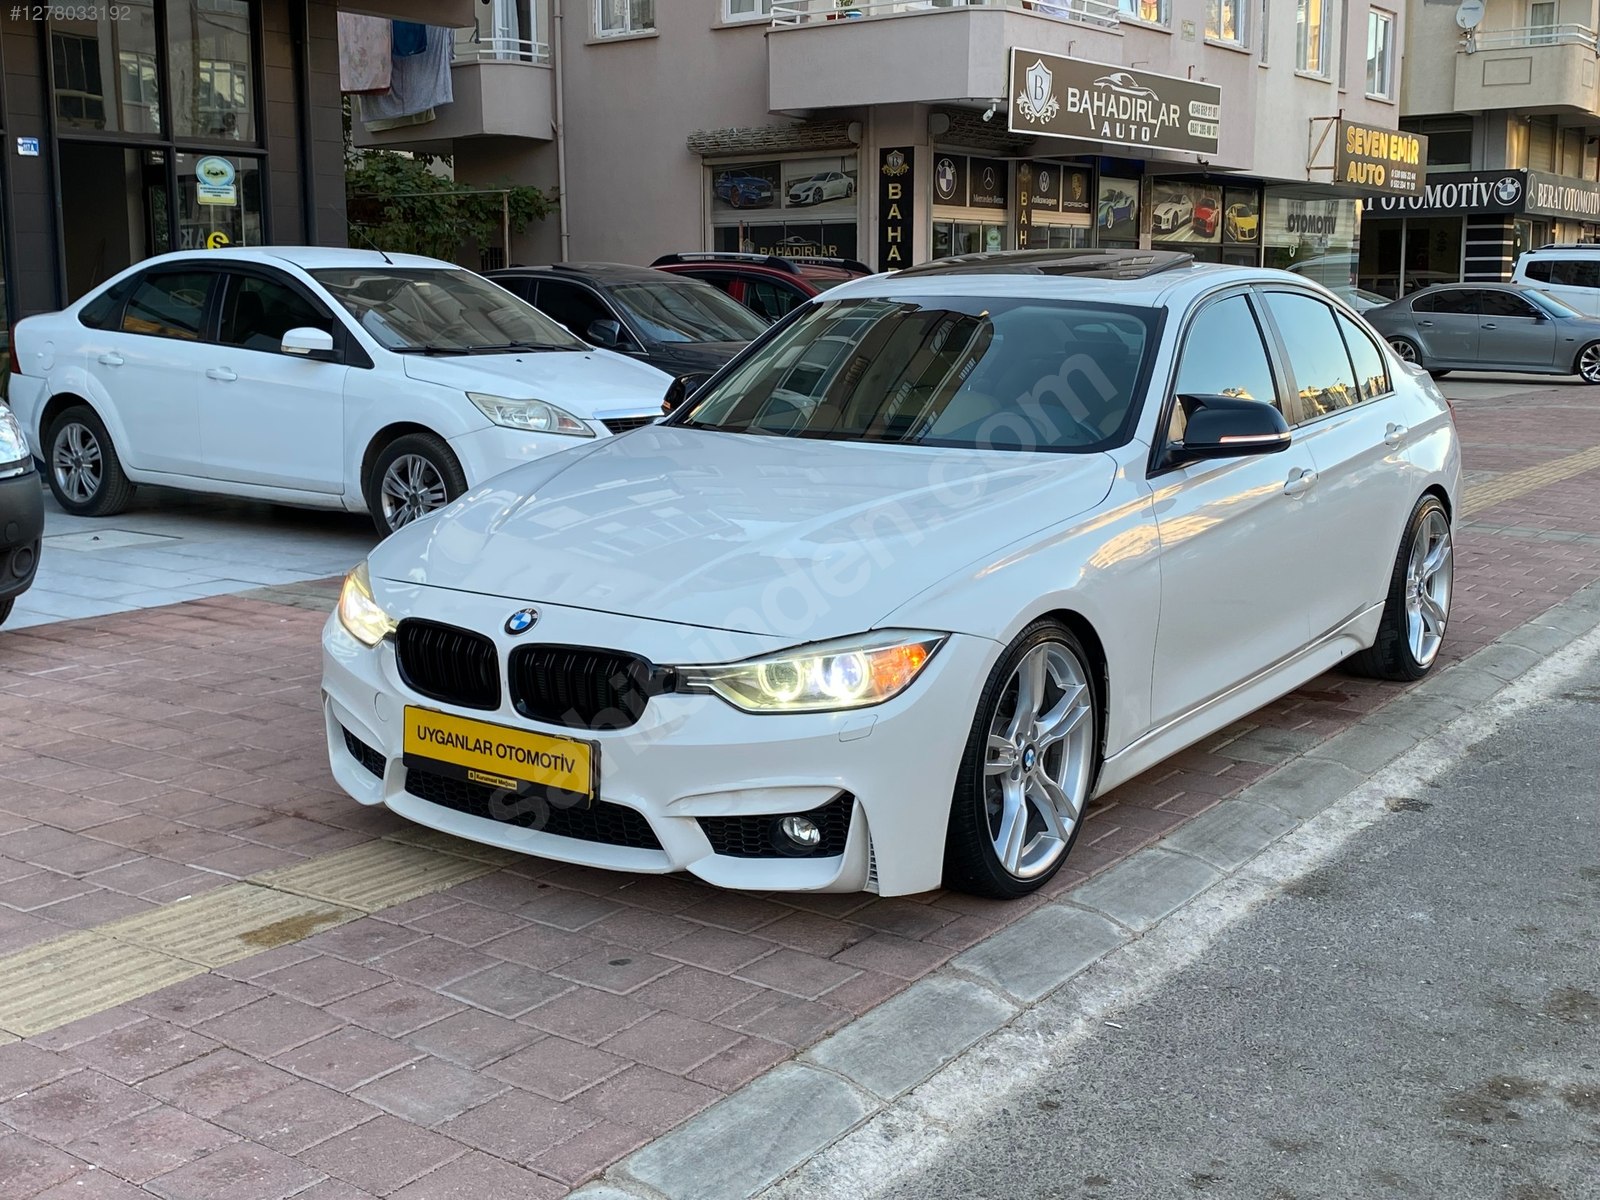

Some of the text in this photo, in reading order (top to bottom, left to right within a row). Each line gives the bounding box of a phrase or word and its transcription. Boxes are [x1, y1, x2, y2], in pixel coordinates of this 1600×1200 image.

[1067, 87, 1180, 138] BAHADIRLAR
[1101, 120, 1150, 141] AUTO
[1346, 125, 1419, 165] SEVEN EMİR
[1346, 160, 1385, 186] AUTO
[1537, 183, 1564, 209] BERAT
[887, 183, 902, 272] BAHA
[1020, 191, 1028, 250] BAH
[417, 724, 575, 774] UYGANLAR OTOMOTİV
